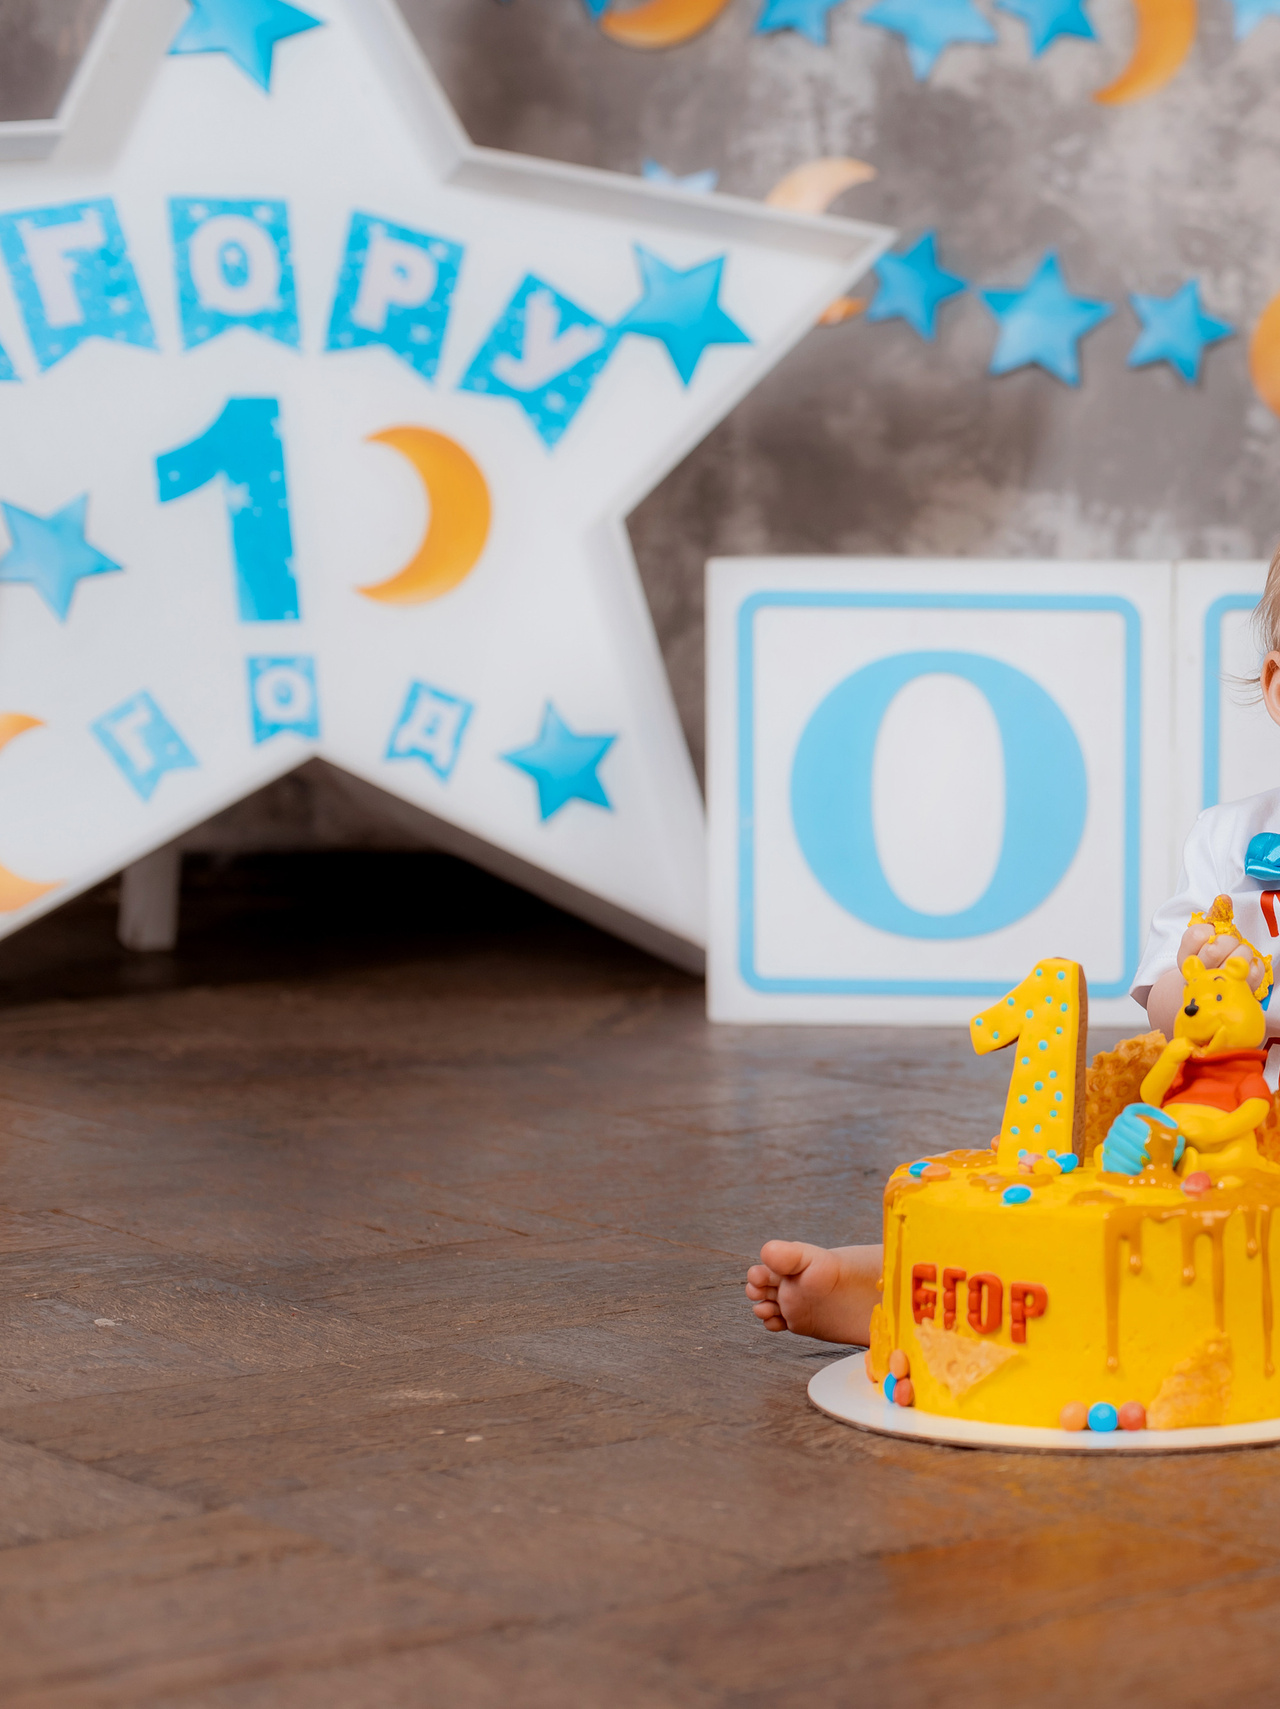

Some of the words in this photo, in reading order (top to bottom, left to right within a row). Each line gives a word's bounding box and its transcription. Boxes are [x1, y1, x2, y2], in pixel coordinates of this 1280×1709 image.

[14, 208, 602, 392] ГОРУ
[154, 397, 302, 623] 1
[112, 664, 463, 777] ГОД
[970, 957, 1087, 1167] 1
[911, 1263, 1048, 1345] ЕГОР
